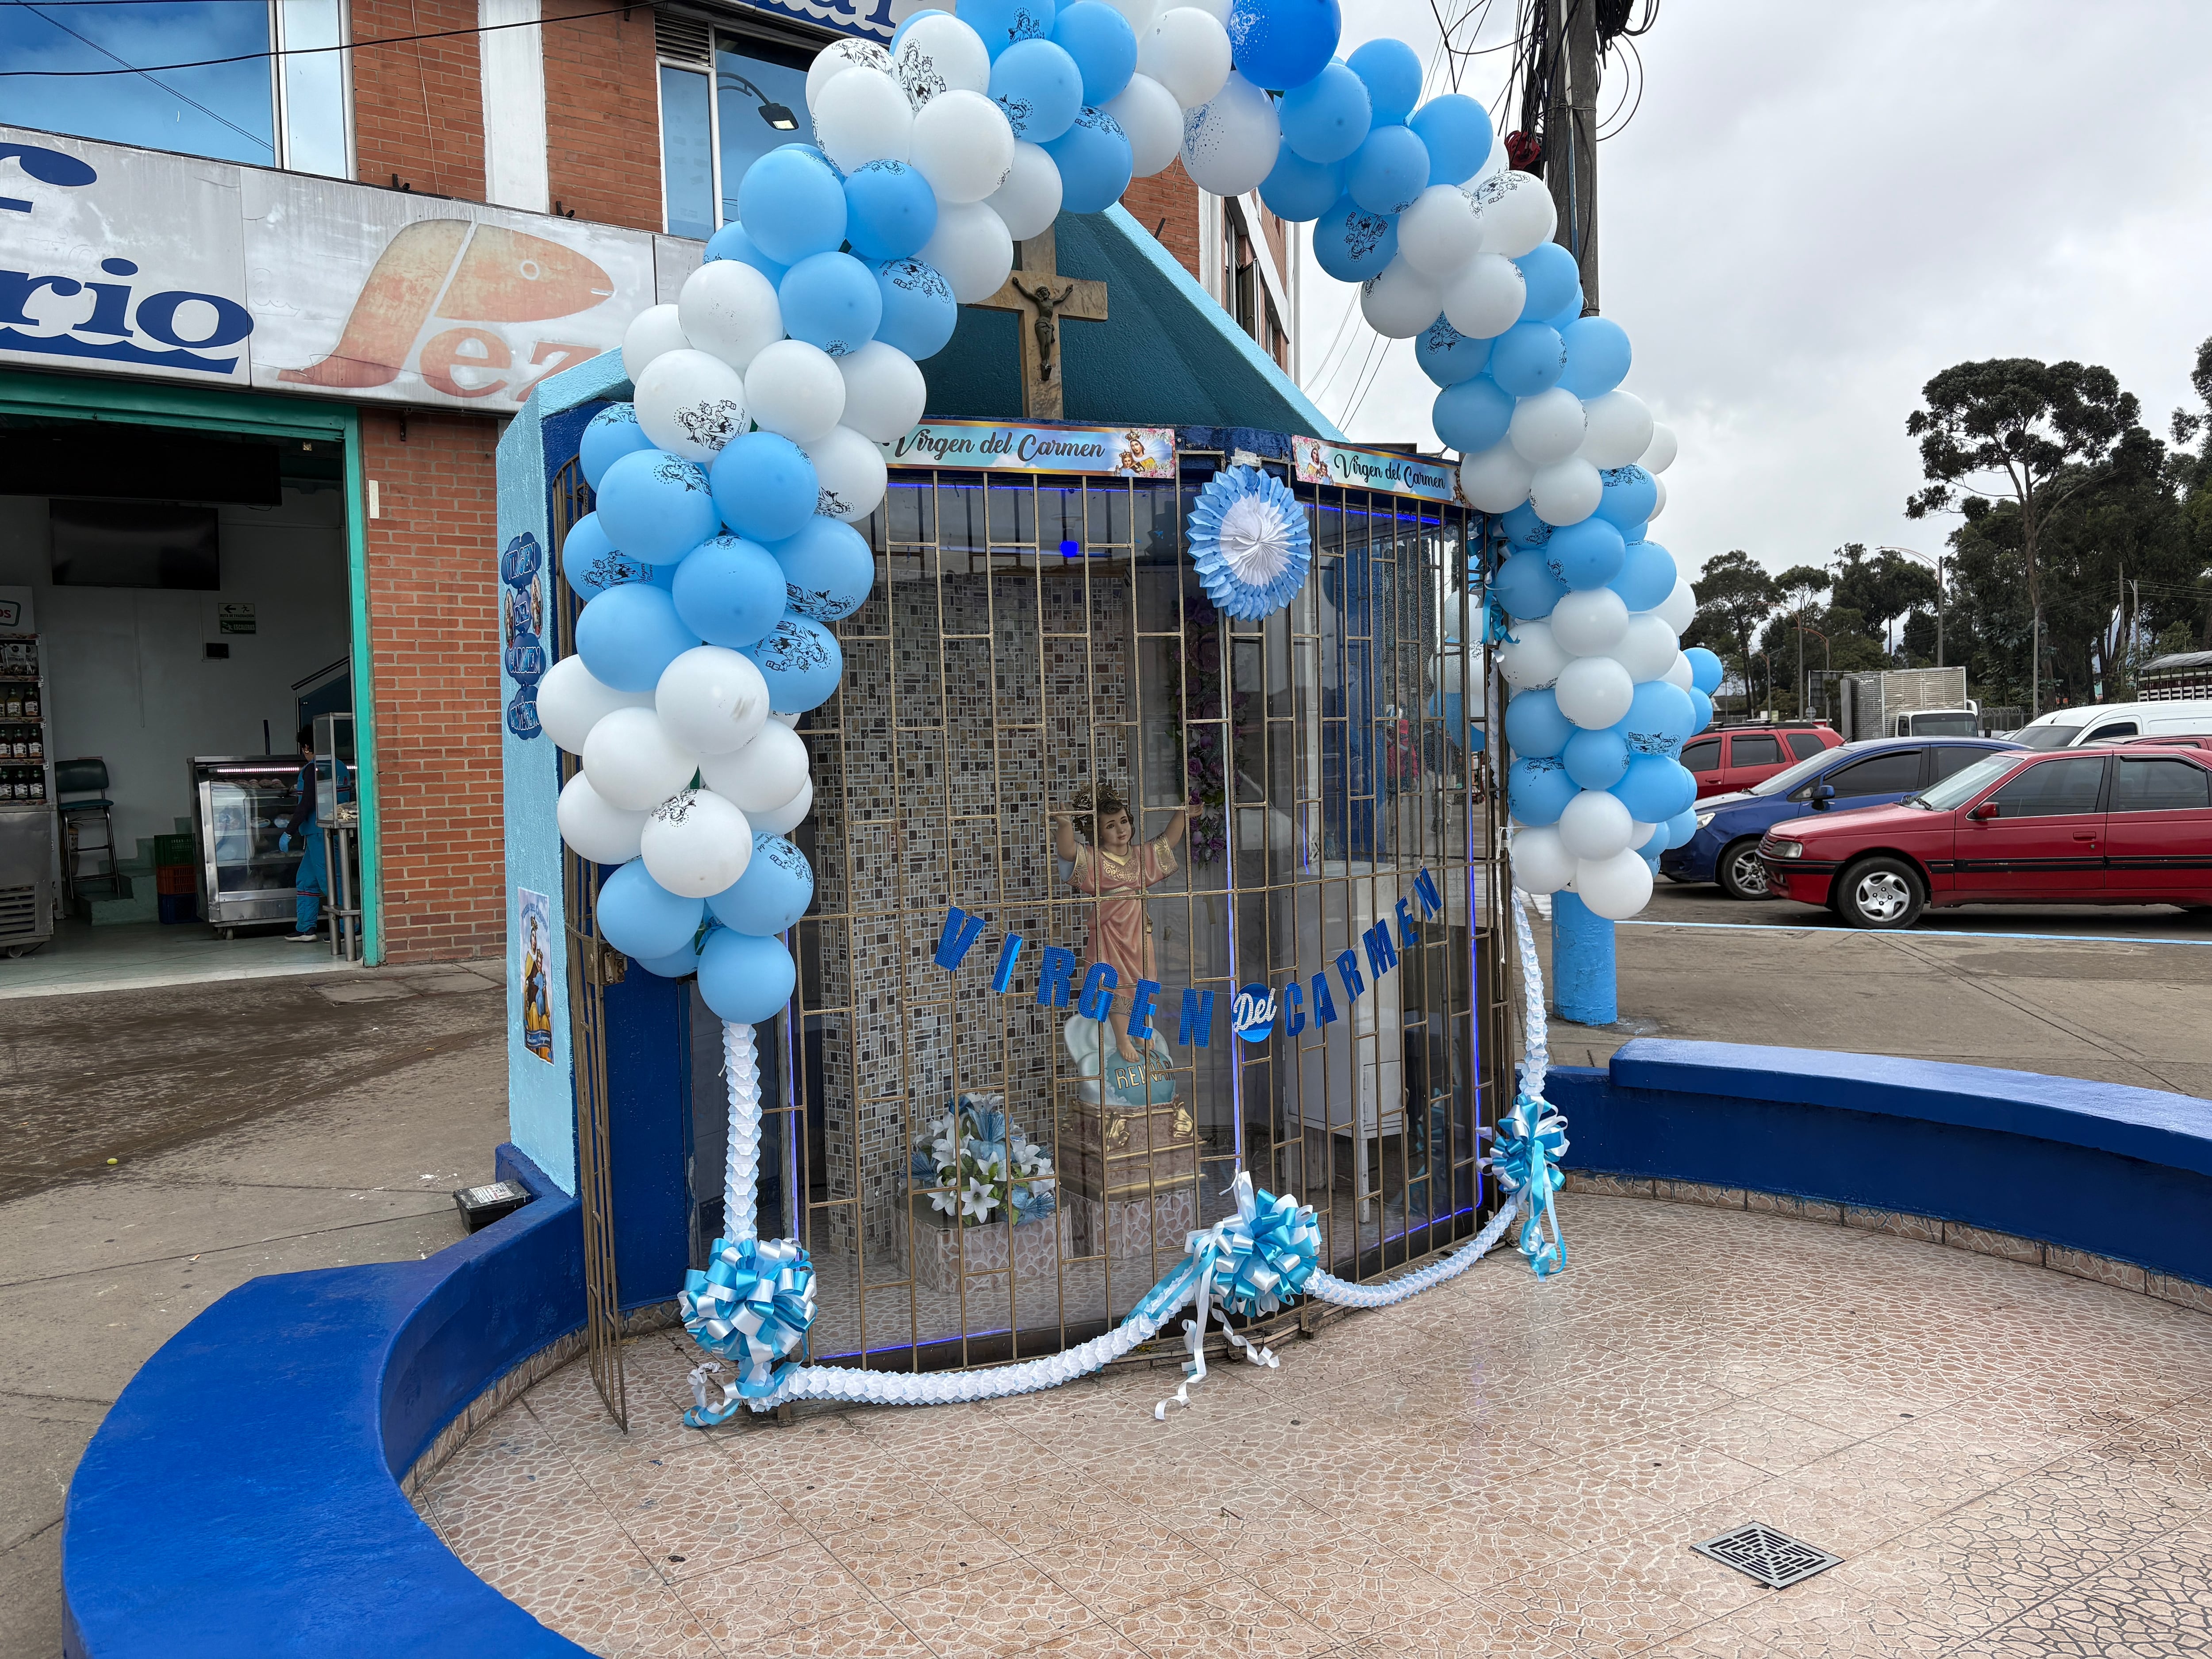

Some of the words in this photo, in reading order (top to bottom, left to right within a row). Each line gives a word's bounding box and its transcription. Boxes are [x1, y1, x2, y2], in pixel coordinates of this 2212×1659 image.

[883, 428, 975, 461] Virgen
[979, 431, 1013, 455] del
[1017, 434, 1106, 462] Carmen
[1334, 453, 1382, 483] Virgen
[1385, 462, 1401, 481] del
[1404, 466, 1446, 489] Carmen
[505, 542, 536, 580] VIRGEN
[514, 600, 530, 627] DEL
[509, 645, 541, 675] CARMEN
[934, 906, 1215, 1048] VIRGEN
[1232, 987, 1278, 1033] Del
[1284, 866, 1443, 1037] CARMEN
